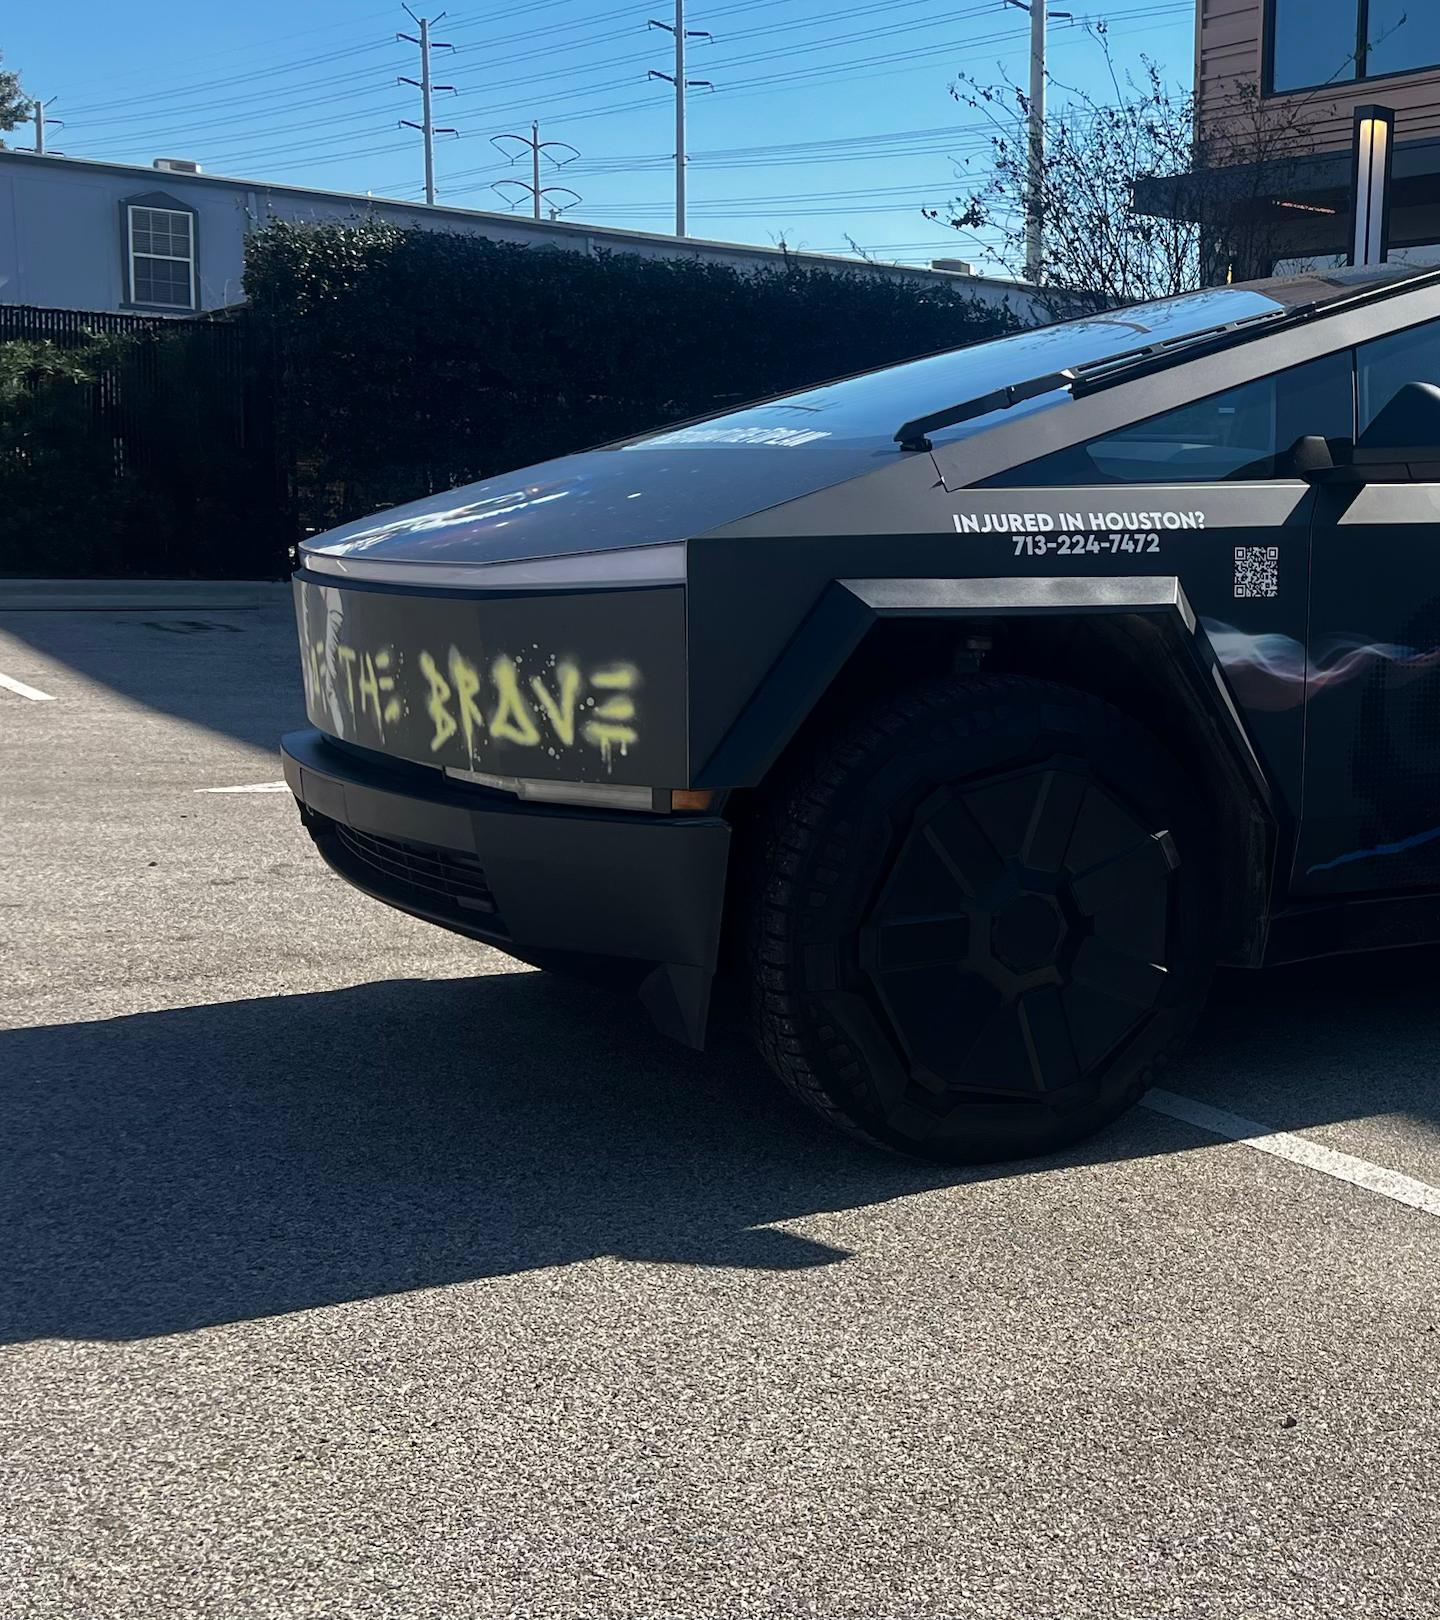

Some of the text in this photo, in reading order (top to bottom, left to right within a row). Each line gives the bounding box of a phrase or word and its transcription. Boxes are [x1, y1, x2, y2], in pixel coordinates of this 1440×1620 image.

[953, 510, 1206, 533] INJURED IN HOUSTON?
[1012, 533, 1160, 555] 713-224-7472
[337, 644, 400, 744] THE
[418, 645, 640, 765] BRAVE
